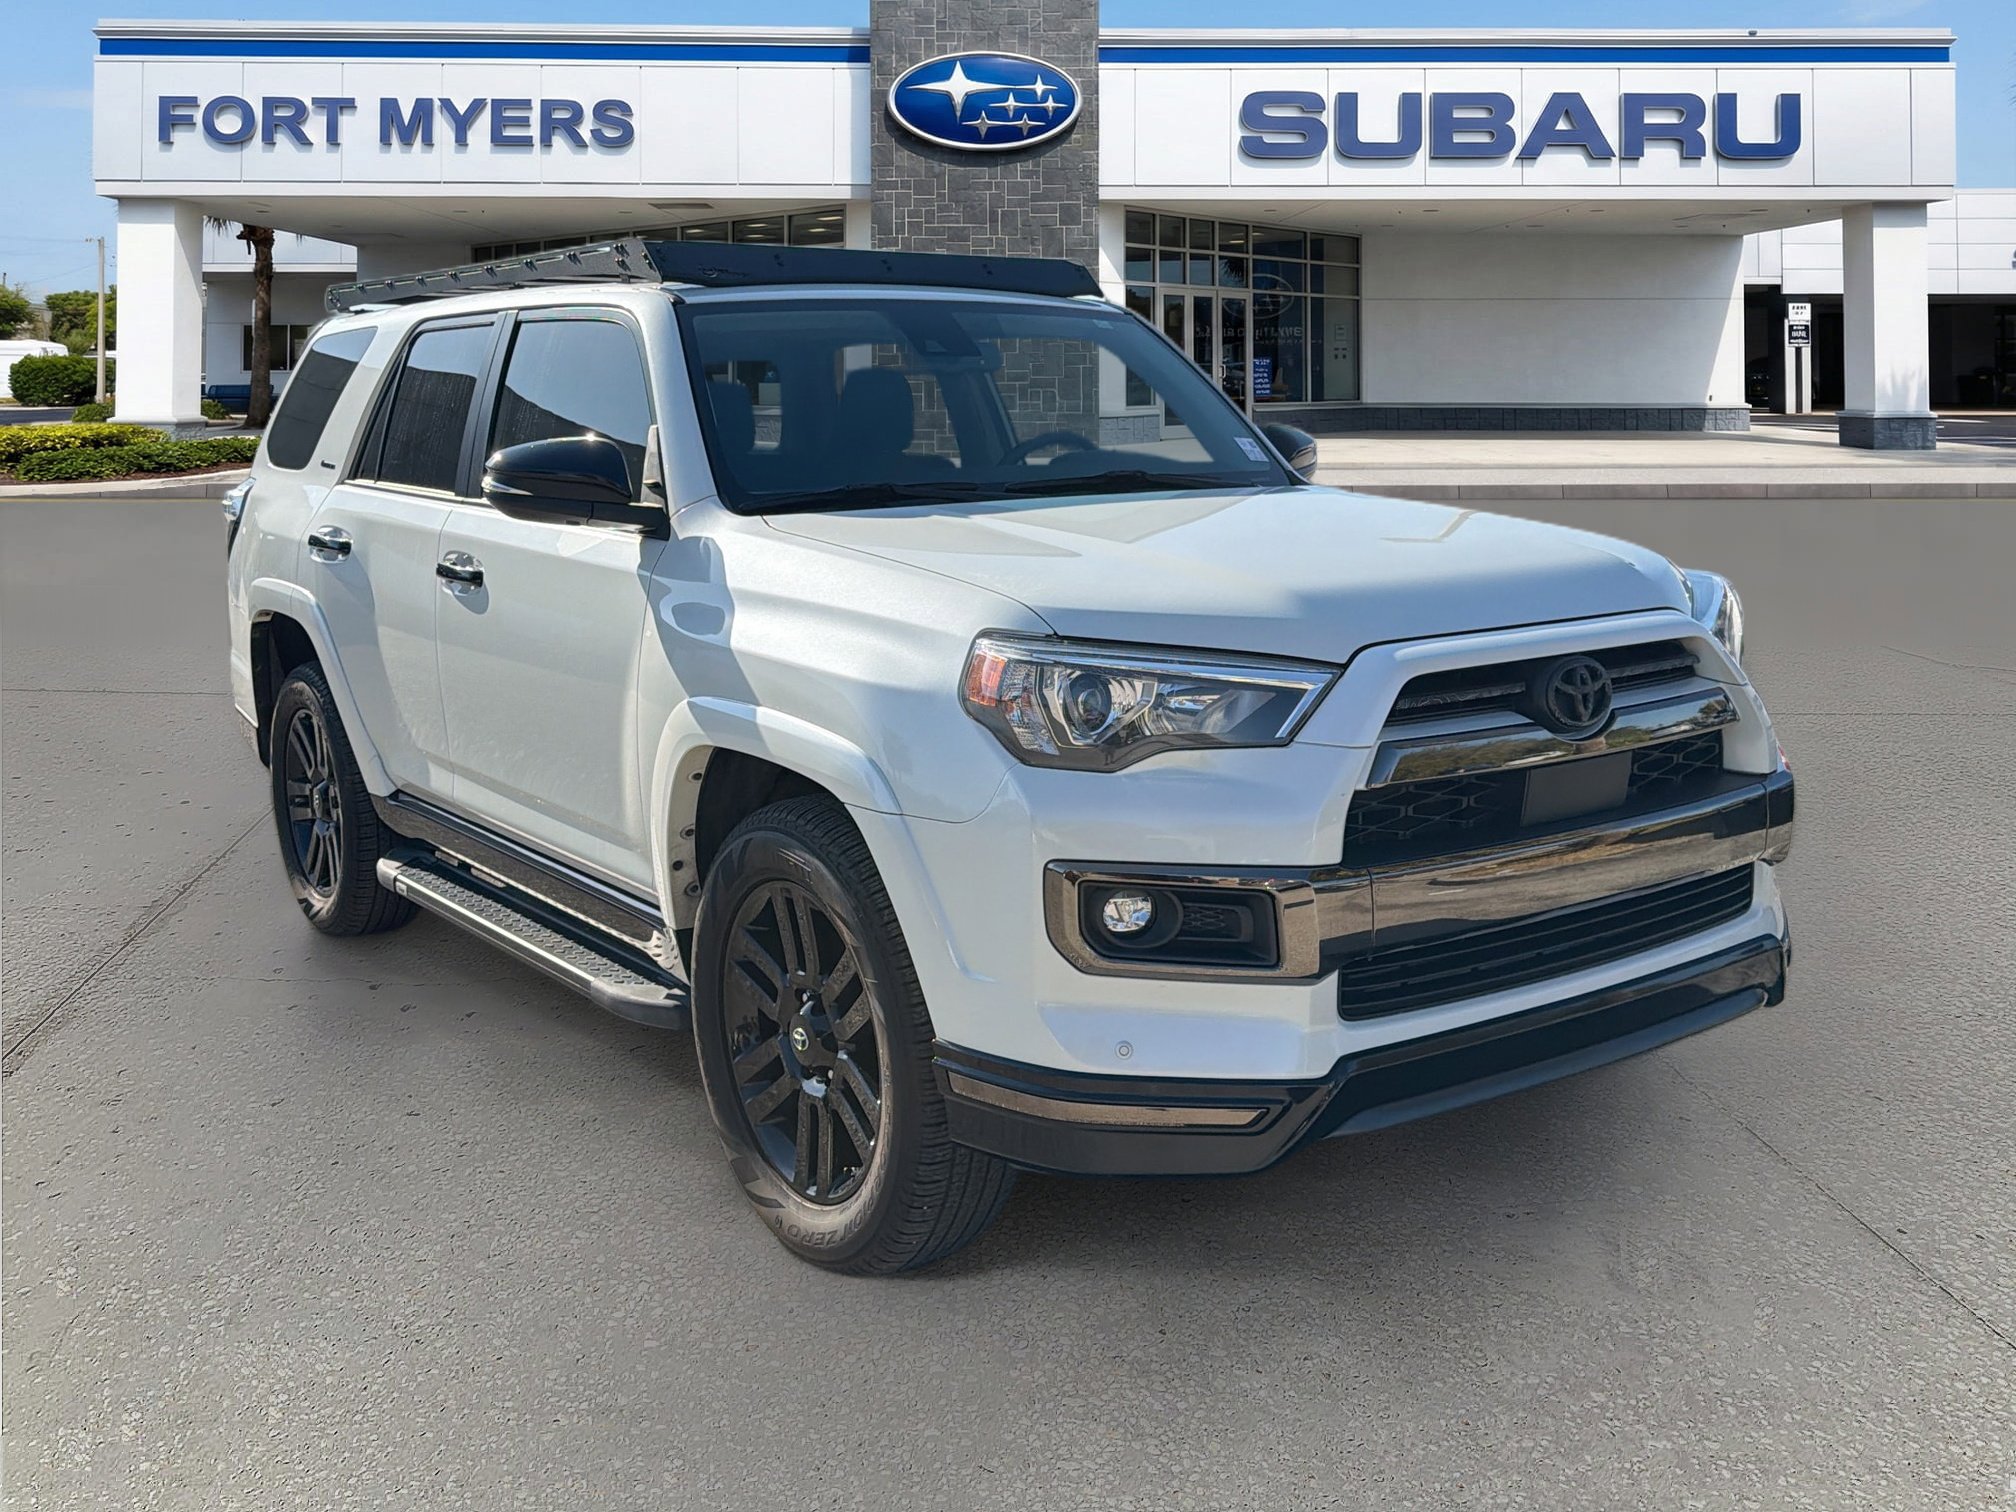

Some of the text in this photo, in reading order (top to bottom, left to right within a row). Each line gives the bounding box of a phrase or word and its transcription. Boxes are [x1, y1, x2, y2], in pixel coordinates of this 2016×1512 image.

[158, 95, 635, 149] FORT MYERS
[1239, 91, 1801, 160] SUBARU
[786, 1223, 839, 1248] ZERO
